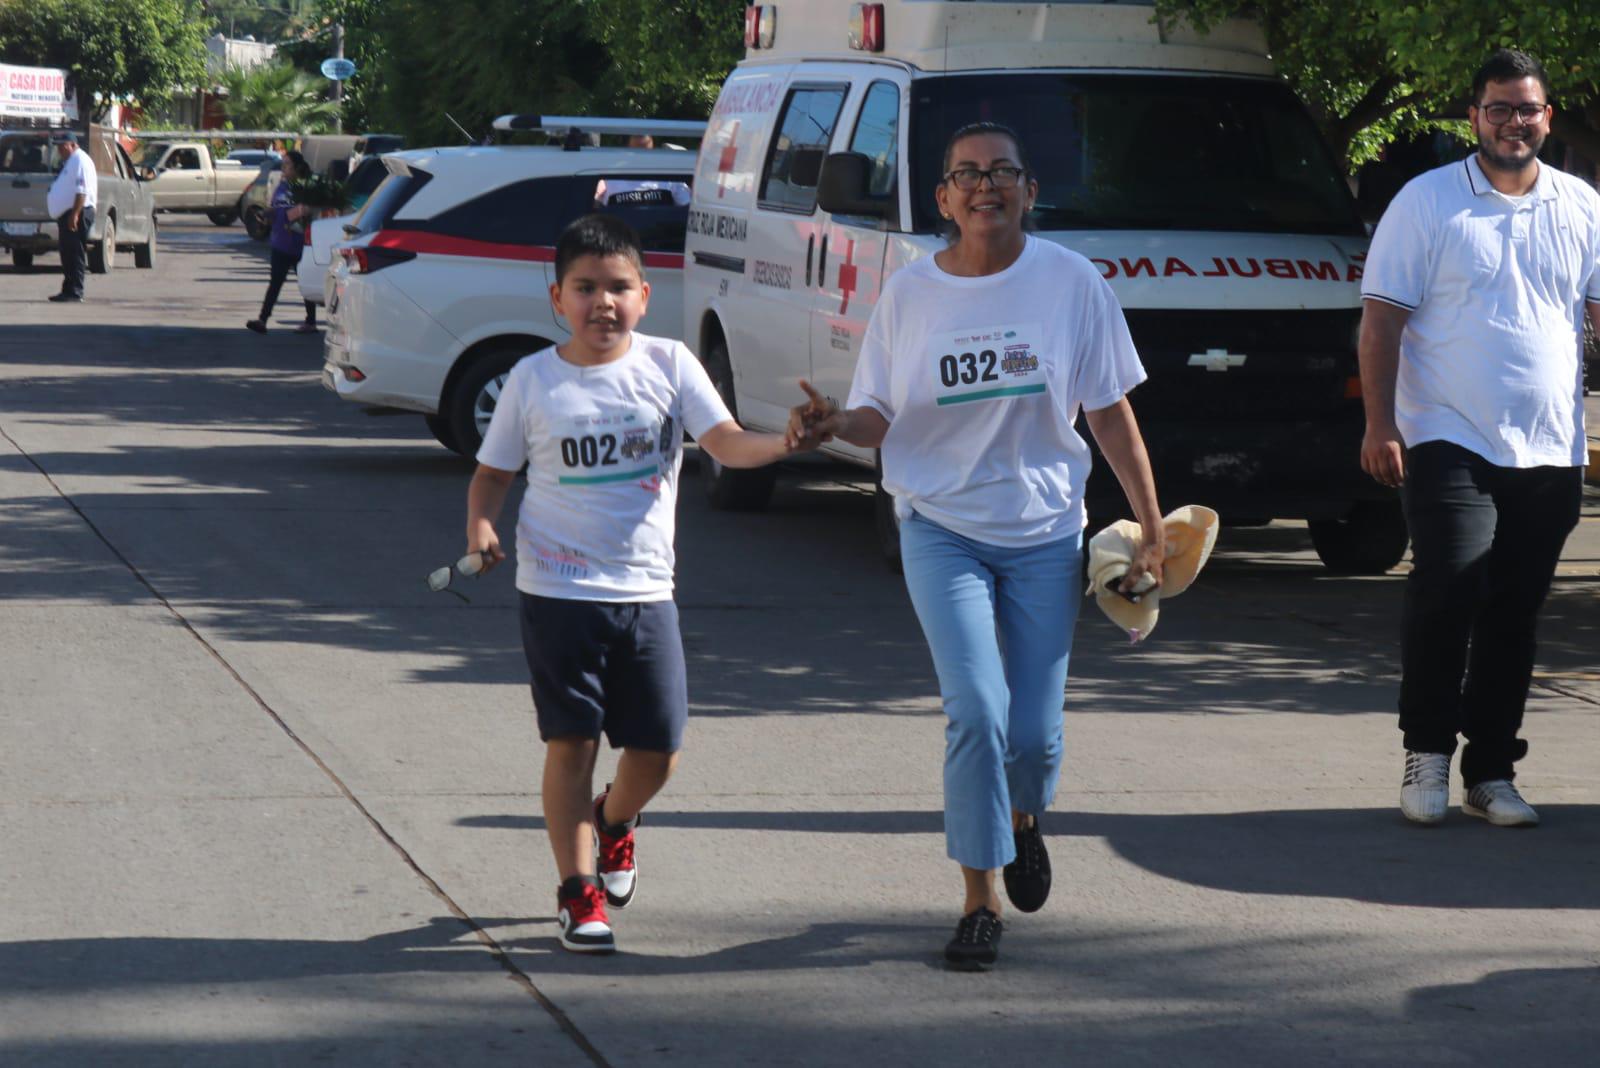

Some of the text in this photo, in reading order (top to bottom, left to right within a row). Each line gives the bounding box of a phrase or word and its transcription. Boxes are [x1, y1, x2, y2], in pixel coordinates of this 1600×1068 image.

[9, 72, 63, 92] CASA ROJO
[701, 212, 715, 237] ROJA
[716, 214, 747, 243] MEXICANA
[939, 349, 998, 387] 032
[560, 433, 618, 468] 002
